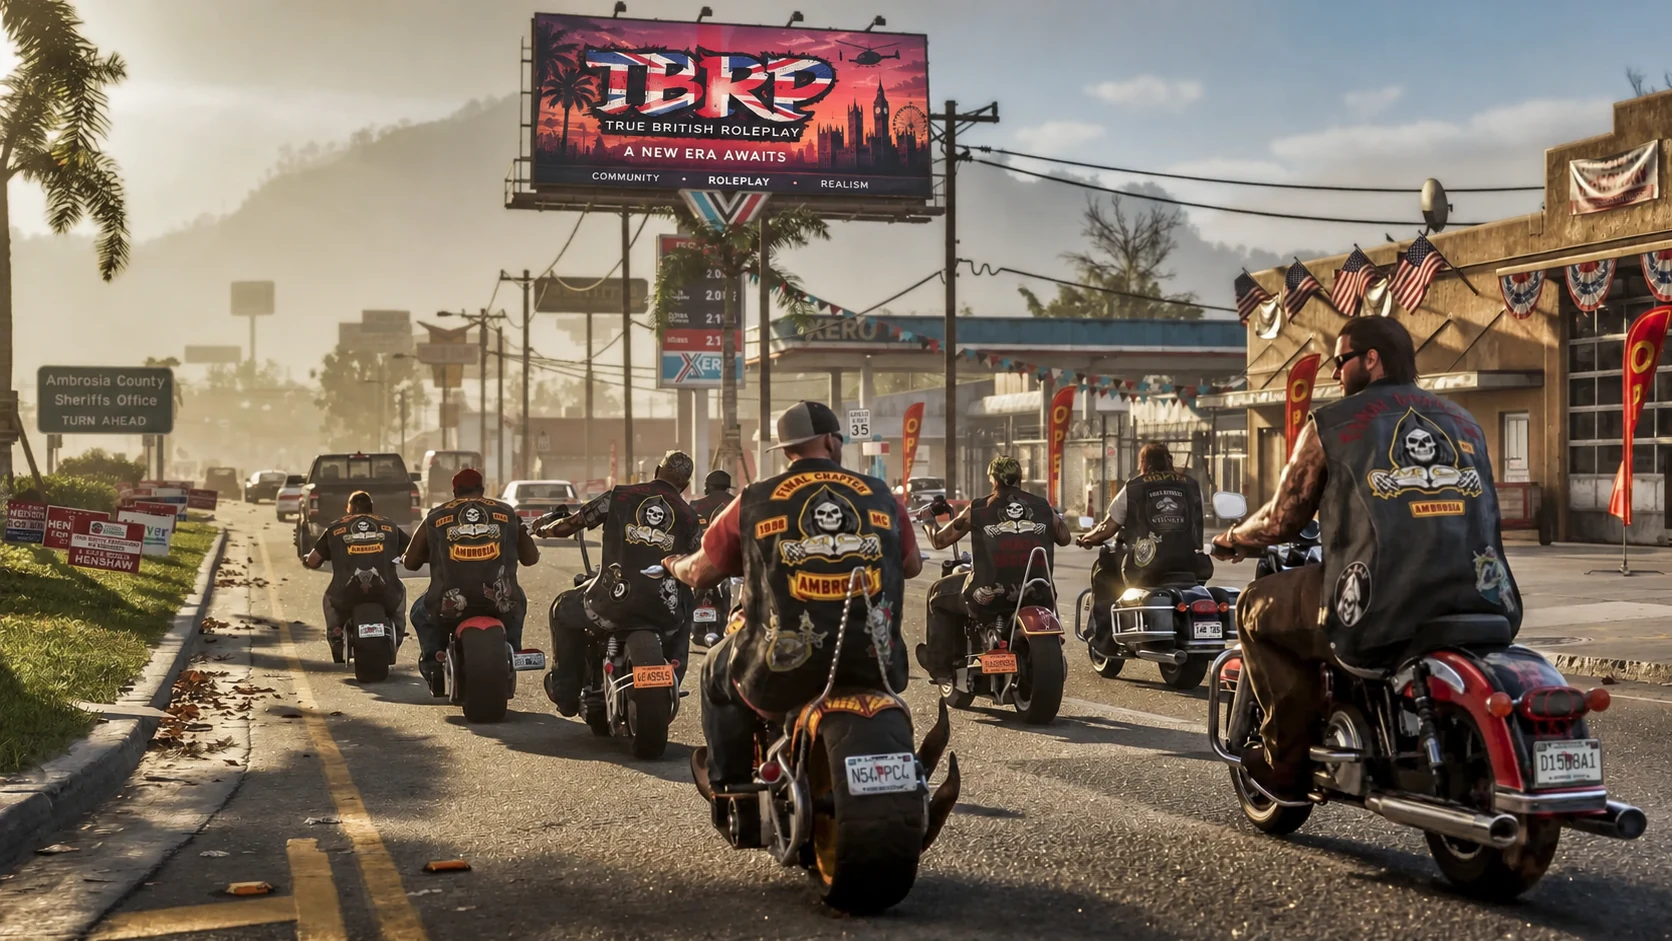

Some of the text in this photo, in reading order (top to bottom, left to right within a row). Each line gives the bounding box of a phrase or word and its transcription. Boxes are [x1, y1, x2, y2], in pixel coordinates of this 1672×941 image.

[585, 51, 833, 122] TBRP
[605, 120, 800, 138] TRUE BRITISH ROLEPLAY
[623, 146, 787, 163] A NEW ERA AWAITS
[591, 172, 869, 190] COMMUNITY ROLEPLAY REALISM
[804, 318, 877, 342] XERO
[675, 352, 722, 383] XER
[46, 374, 165, 390] Ambrosia County
[55, 394, 158, 406] Sheriffs Office
[62, 415, 147, 426] TURN AHEAD
[851, 424, 869, 436] 35
[776, 471, 868, 498] FINAL CHAPTER
[872, 513, 889, 526] MC
[75, 555, 133, 570] HENSHAW
